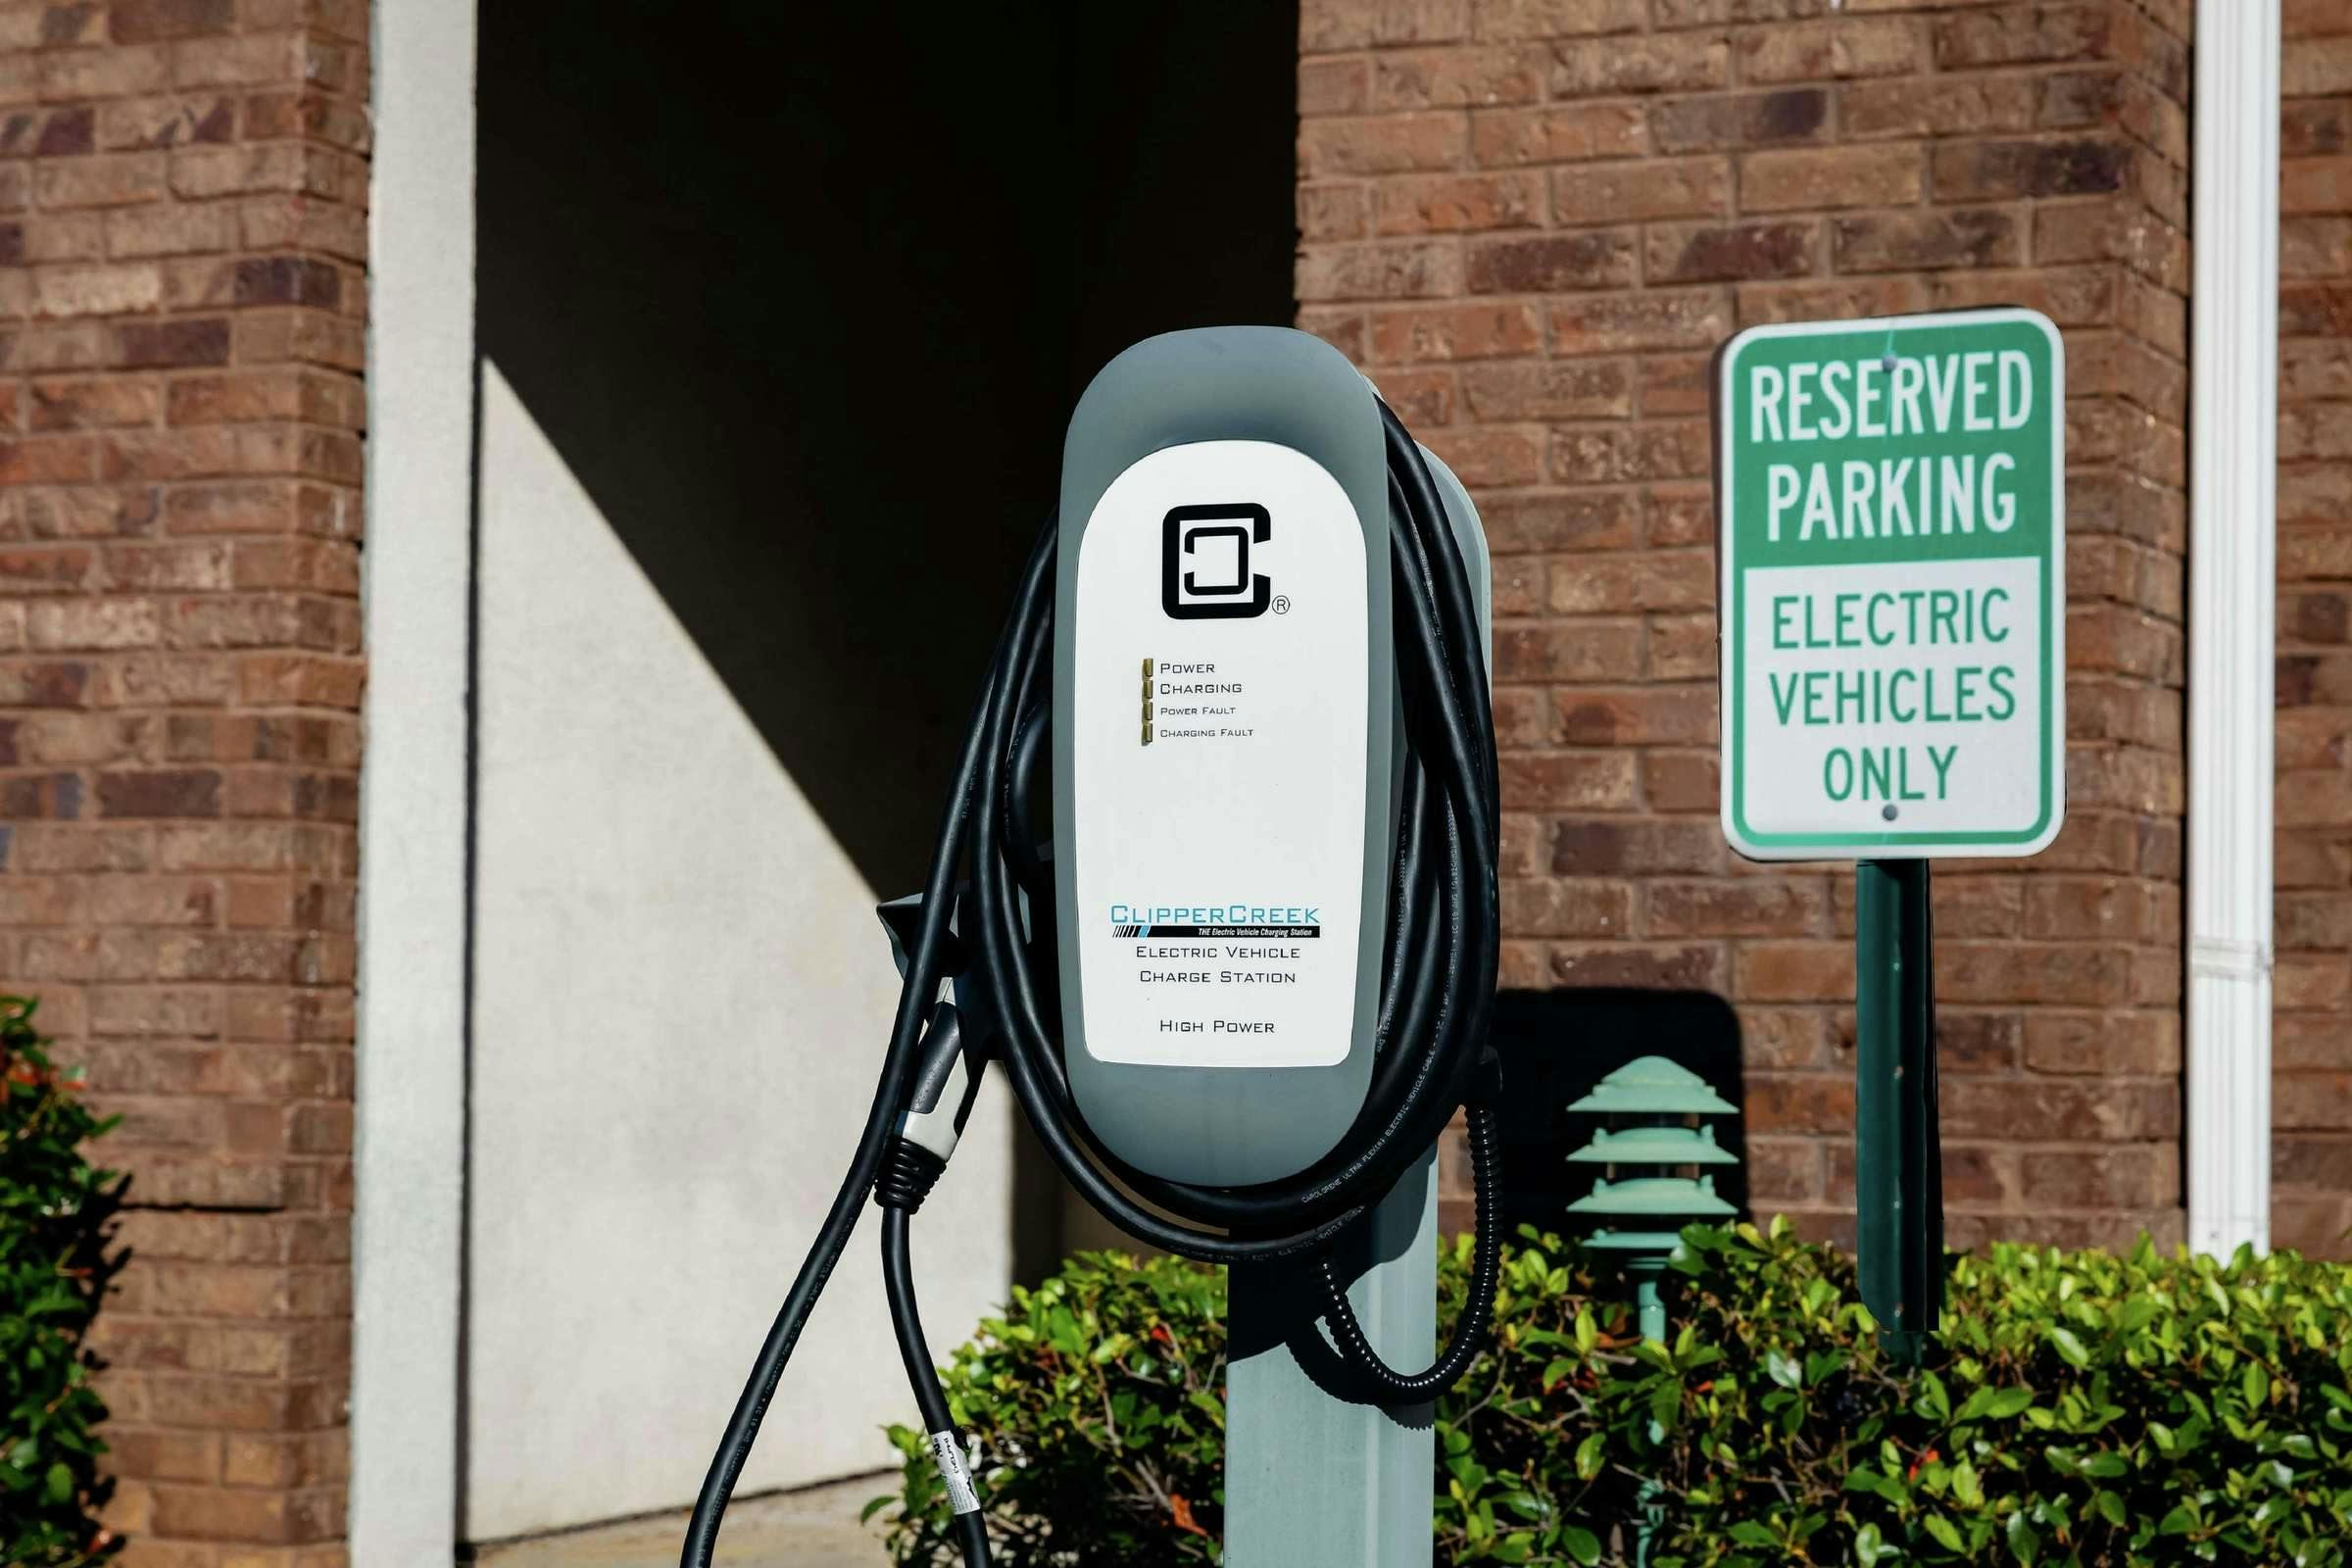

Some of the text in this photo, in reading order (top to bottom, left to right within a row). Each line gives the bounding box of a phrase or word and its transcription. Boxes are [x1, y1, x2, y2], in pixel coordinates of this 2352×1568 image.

[1750, 350, 2034, 442] RESERVED
[1767, 453, 2016, 541] PARKING
[1772, 588, 2009, 649] ELECTRIC
[1159, 662, 1215, 674] POWER
[1159, 683, 1243, 695] CHARGING
[1769, 666, 2016, 725] VEHICLES
[1160, 706, 1237, 716] POWER FAULT
[1159, 728, 1254, 738] CHARGING FAULT
[1824, 746, 1957, 801] ONLY
[1198, 927, 1312, 938] THE Electric Vehicle Charging Station
[1136, 946, 1300, 958] ELECTRIC VEHICLE
[1140, 970, 1296, 984] CHARGE STATION
[1159, 1019, 1275, 1034] HIGH POWER
